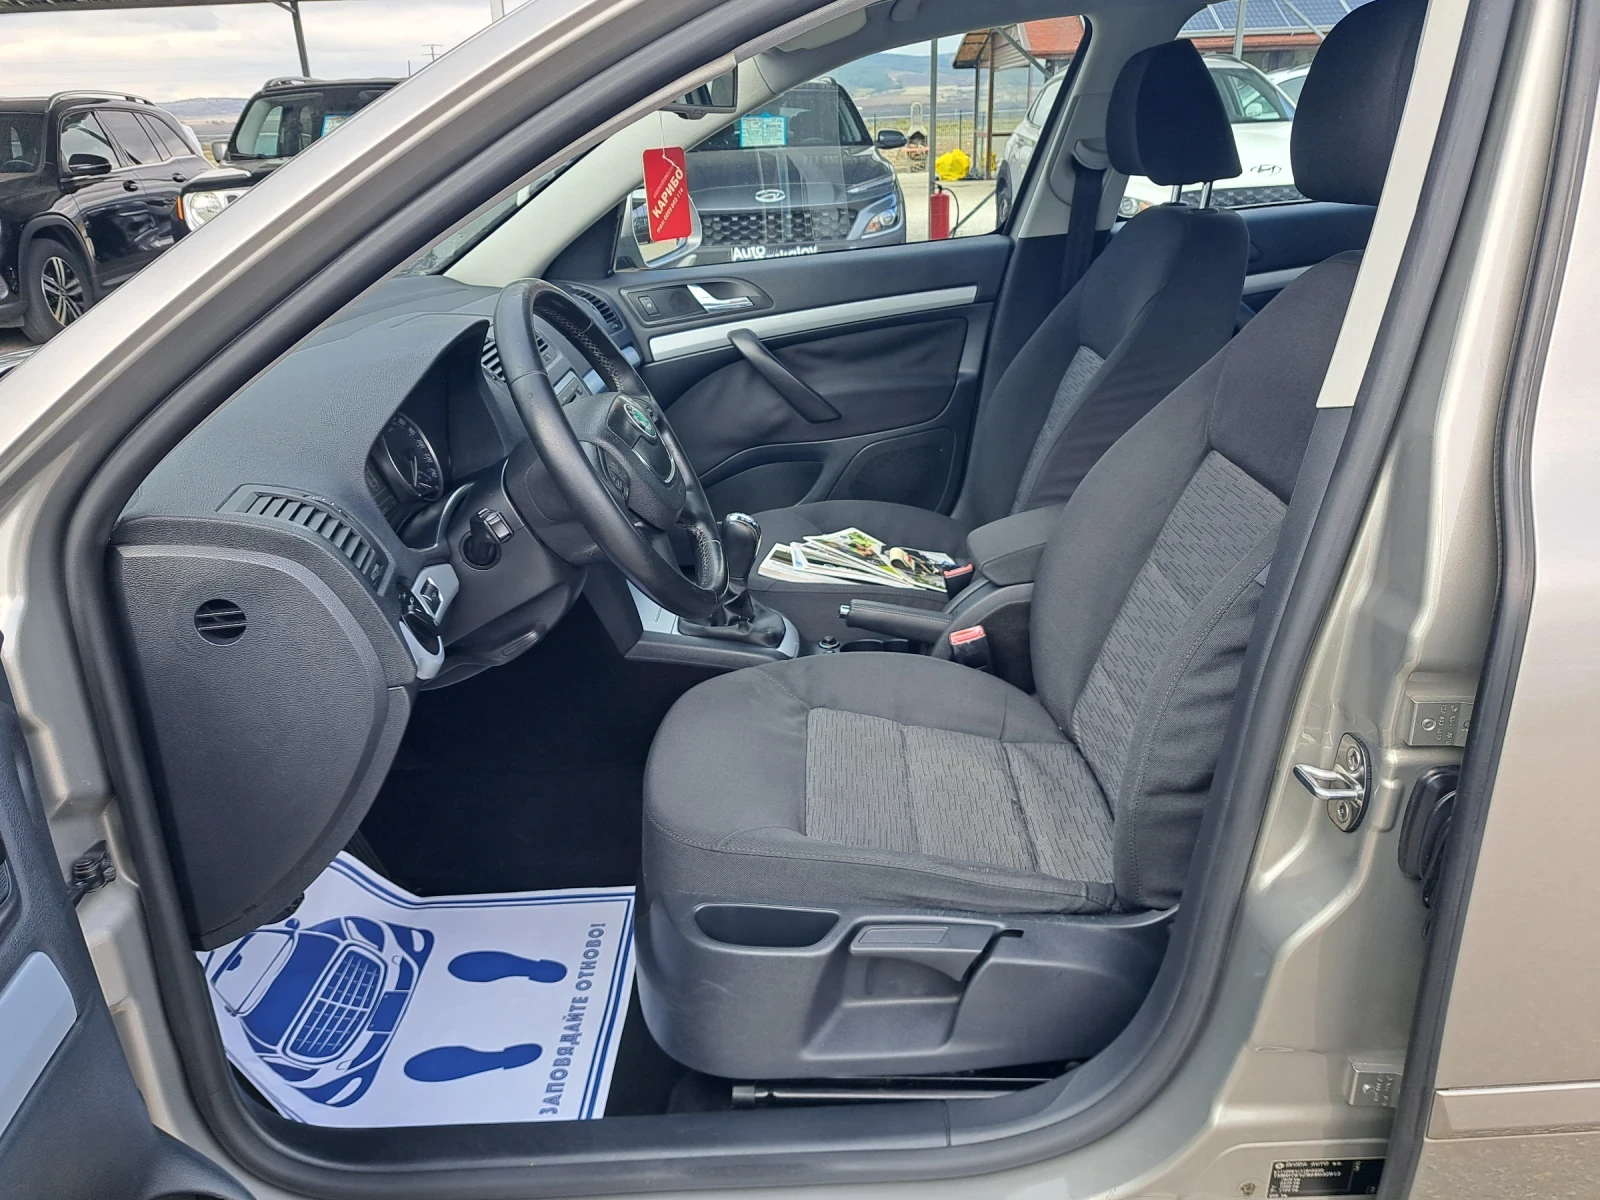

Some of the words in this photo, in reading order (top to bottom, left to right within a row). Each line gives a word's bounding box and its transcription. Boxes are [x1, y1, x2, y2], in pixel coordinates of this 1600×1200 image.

[652, 168, 684, 219] КАРИБО
[538, 996, 589, 1115] ЗАПОВЯДАЙТЕ
[575, 922, 607, 991] ОТНОВО!
